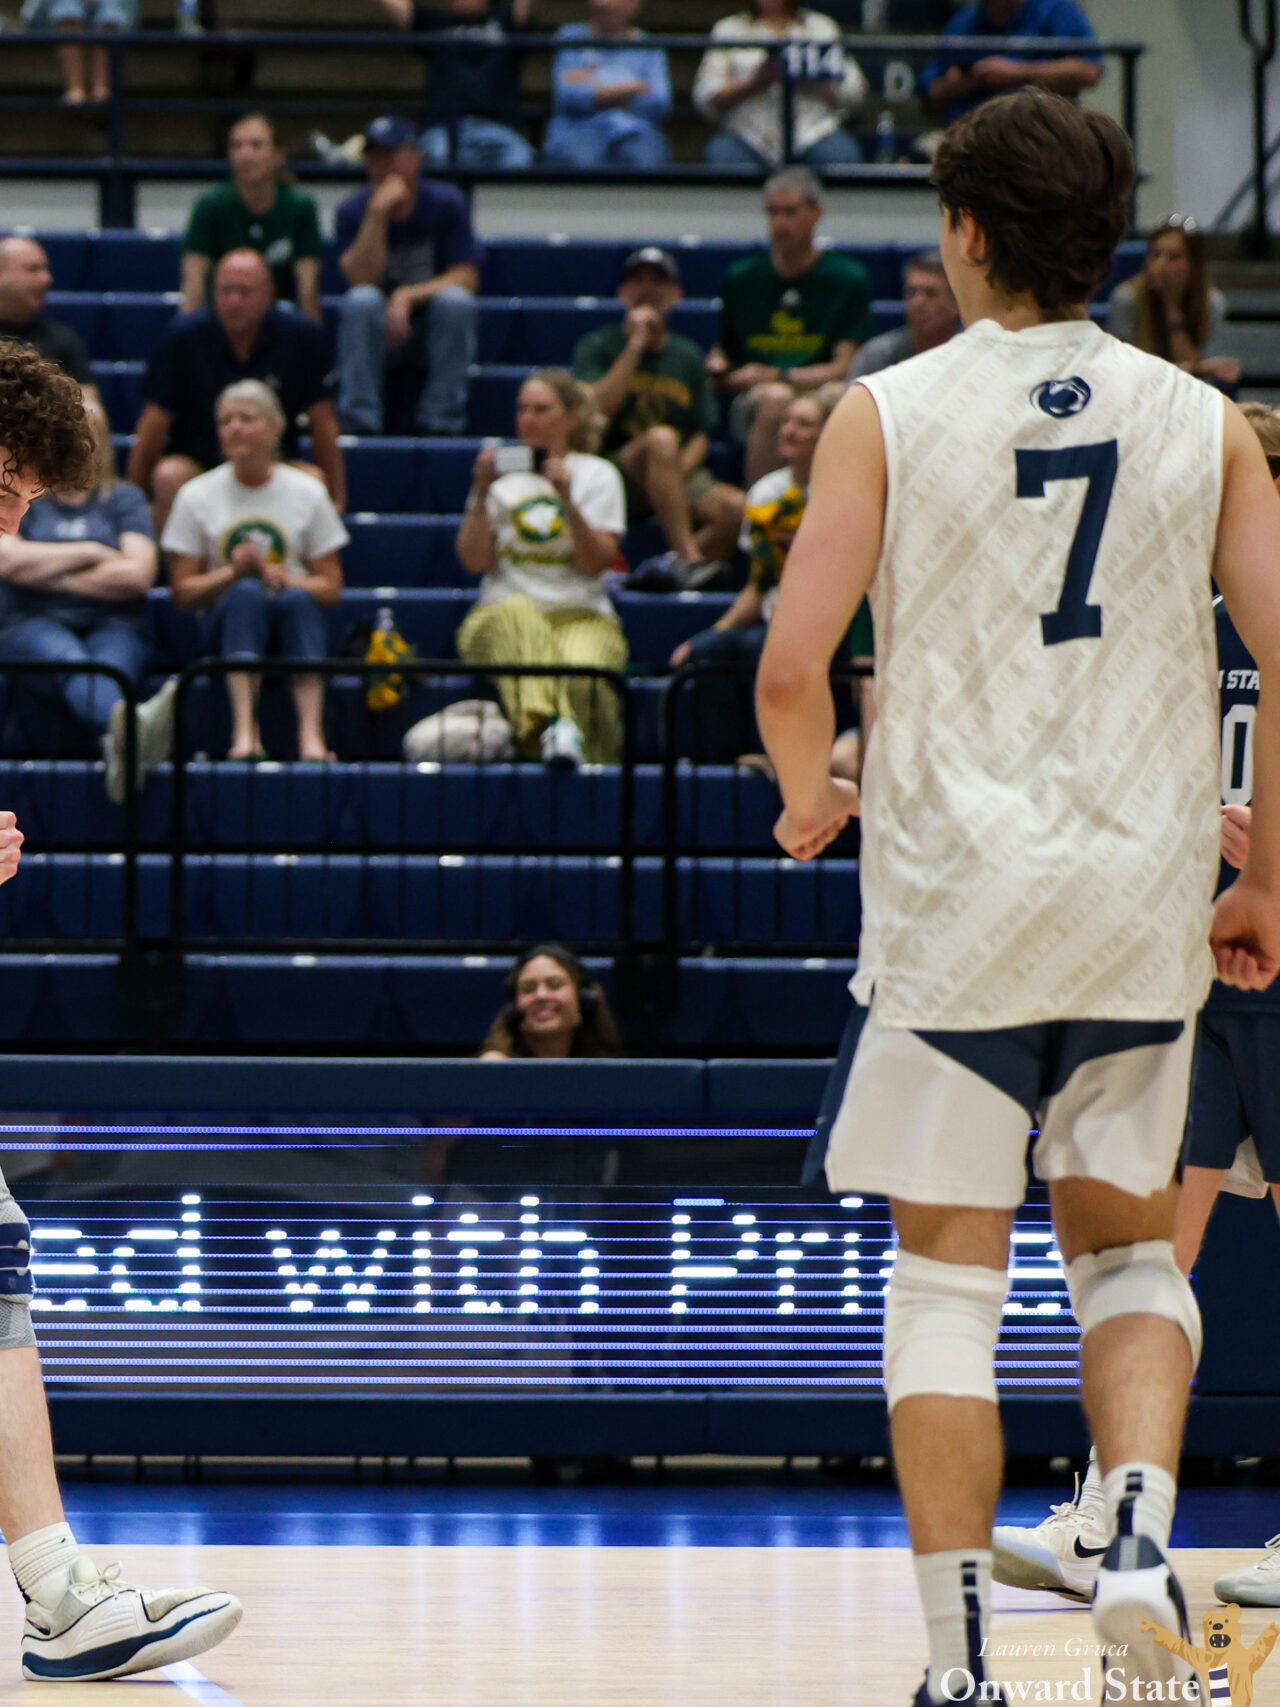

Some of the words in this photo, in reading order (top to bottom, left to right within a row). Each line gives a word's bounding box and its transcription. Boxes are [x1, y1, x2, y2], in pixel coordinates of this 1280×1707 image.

[1014, 437, 1119, 647] 7
[1226, 669, 1260, 690] STA
[265, 1195, 602, 1314] with
[671, 1196, 1068, 1317] Prie
